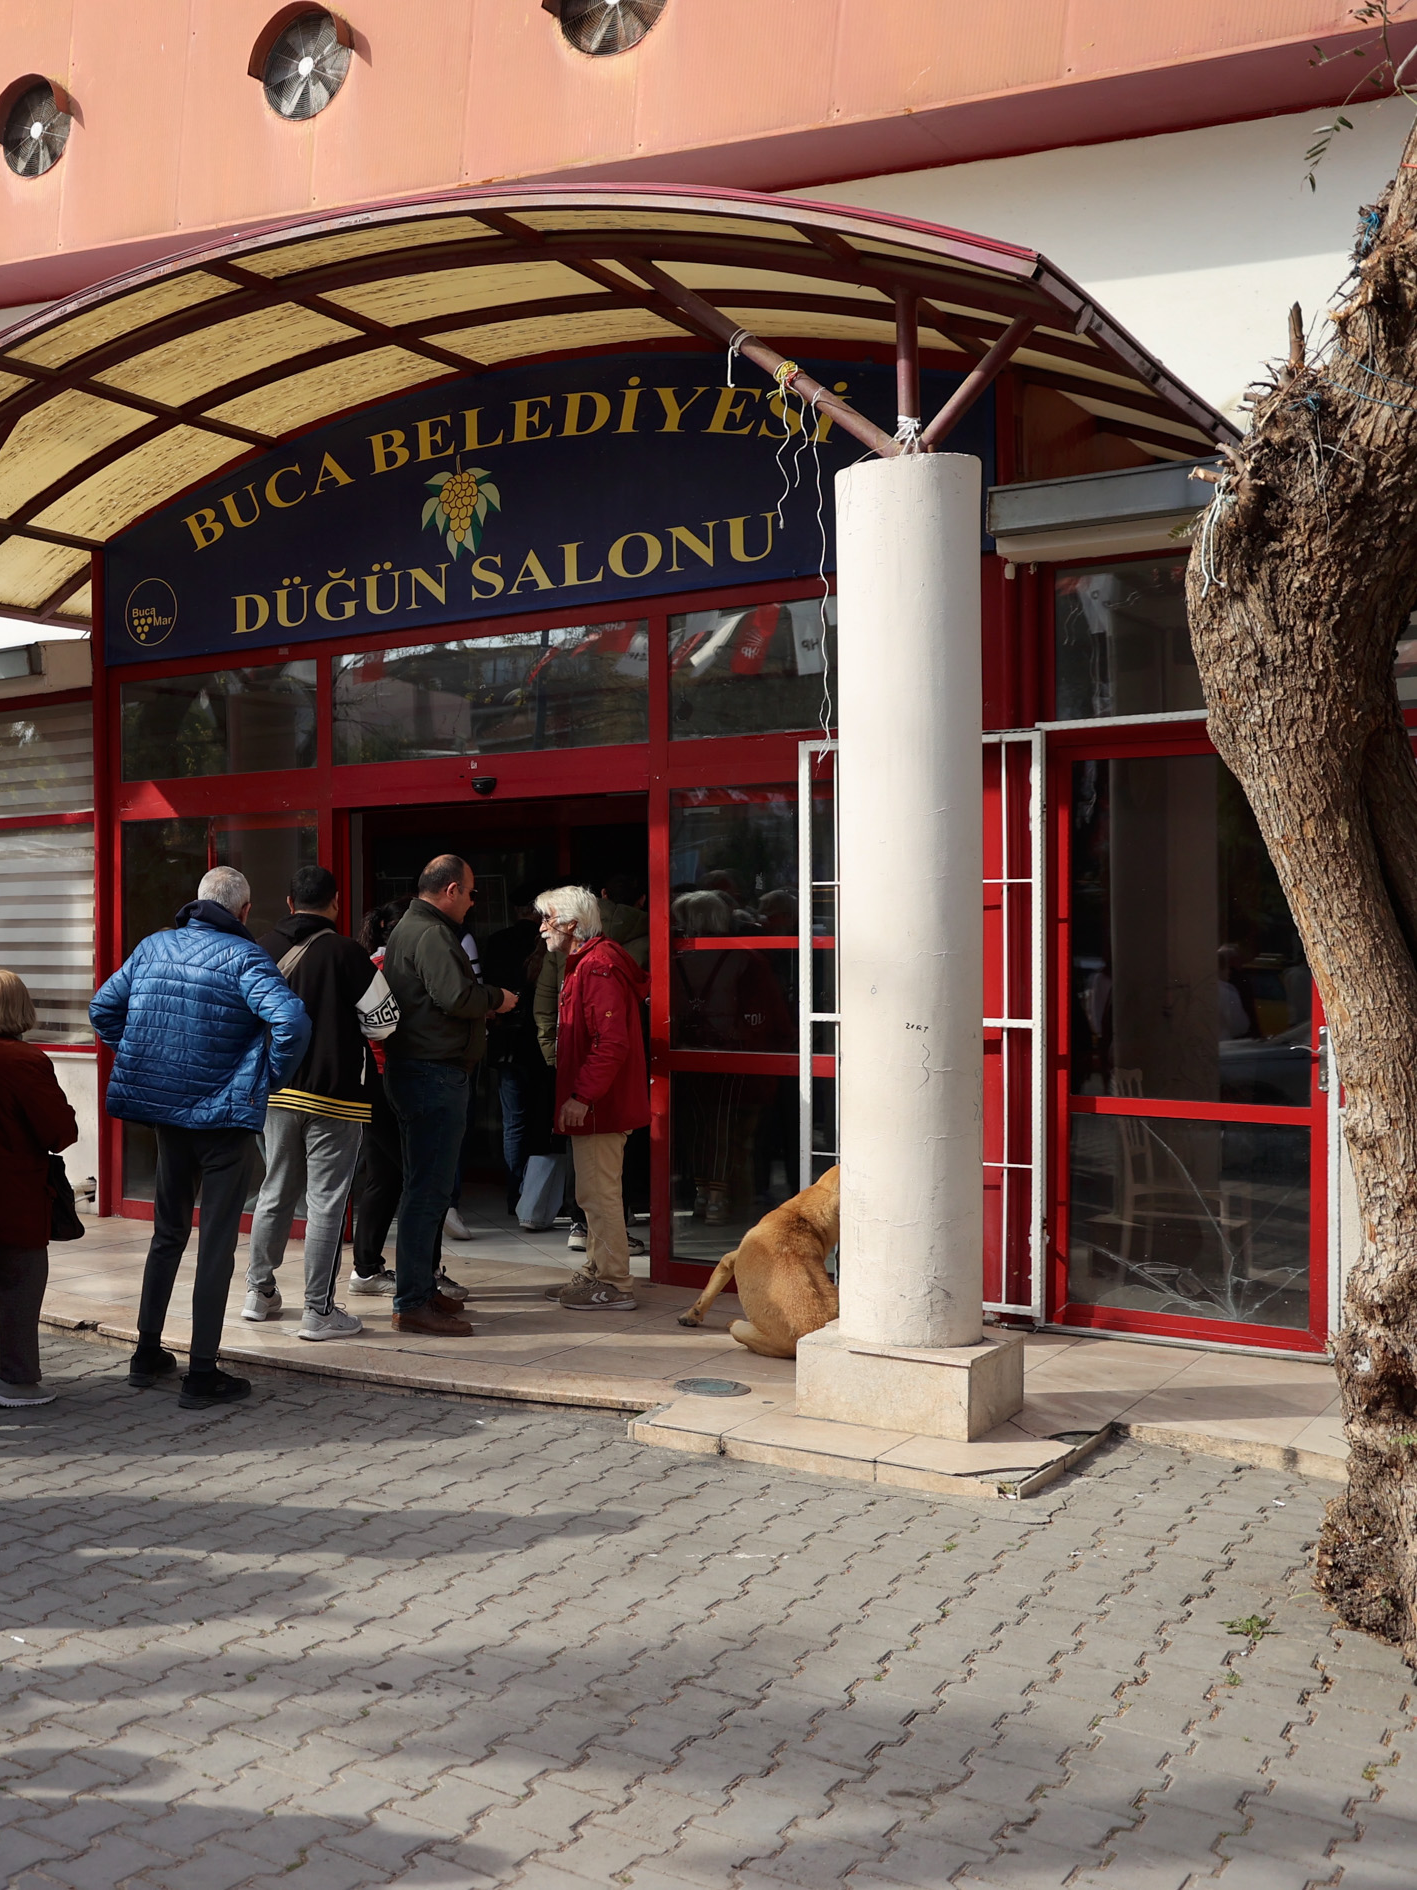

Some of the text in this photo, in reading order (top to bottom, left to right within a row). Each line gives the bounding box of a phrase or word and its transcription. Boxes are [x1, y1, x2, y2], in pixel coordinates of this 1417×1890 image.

[182, 450, 356, 553] BUCA
[232, 512, 779, 635] DÜĞÜN SALONU
[132, 606, 156, 618] Buca
[153, 615, 173, 627] Mar
